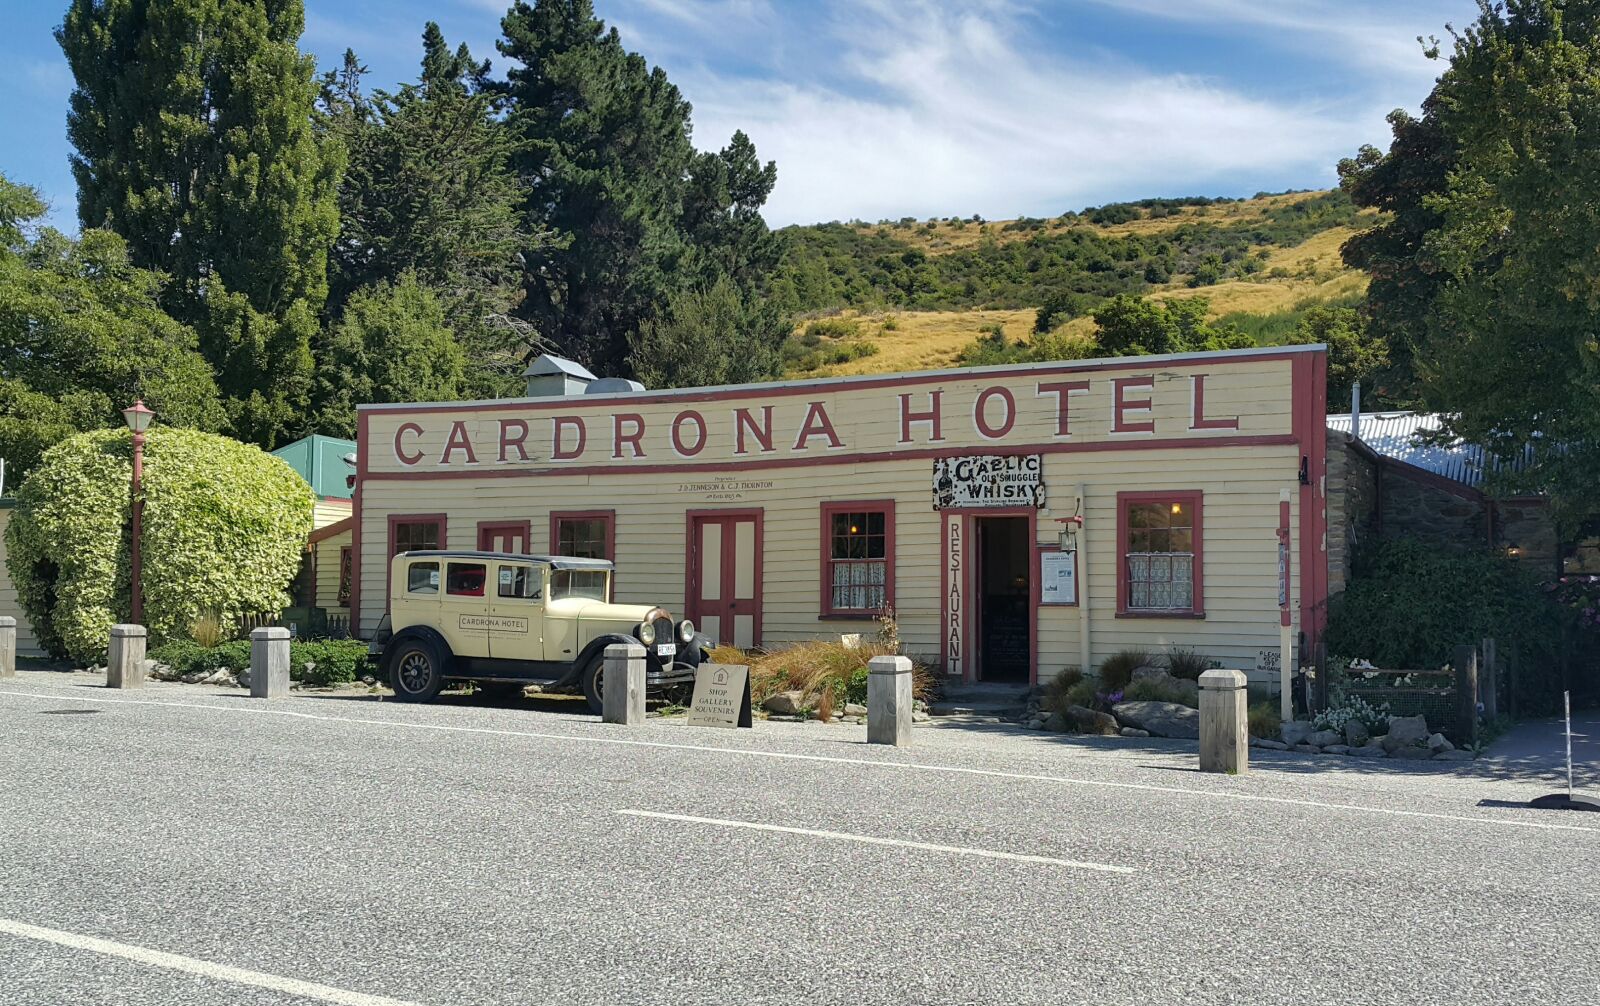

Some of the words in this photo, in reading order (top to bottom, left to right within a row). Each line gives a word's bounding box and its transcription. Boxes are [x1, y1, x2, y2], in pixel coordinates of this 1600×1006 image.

[394, 400, 847, 465] CARDRONA
[897, 373, 1240, 444] HOTEL
[955, 458, 1038, 482] GAELIC
[967, 484, 1037, 498] WHISKY
[950, 523, 960, 672] RESTAURANT
[461, 618, 500, 627] CARDRONA
[501, 620, 524, 628] HOTEL
[709, 688, 728, 696] SHOP
[699, 698, 733, 706] GALLERY
[695, 706, 735, 714] SOUVENIRS
